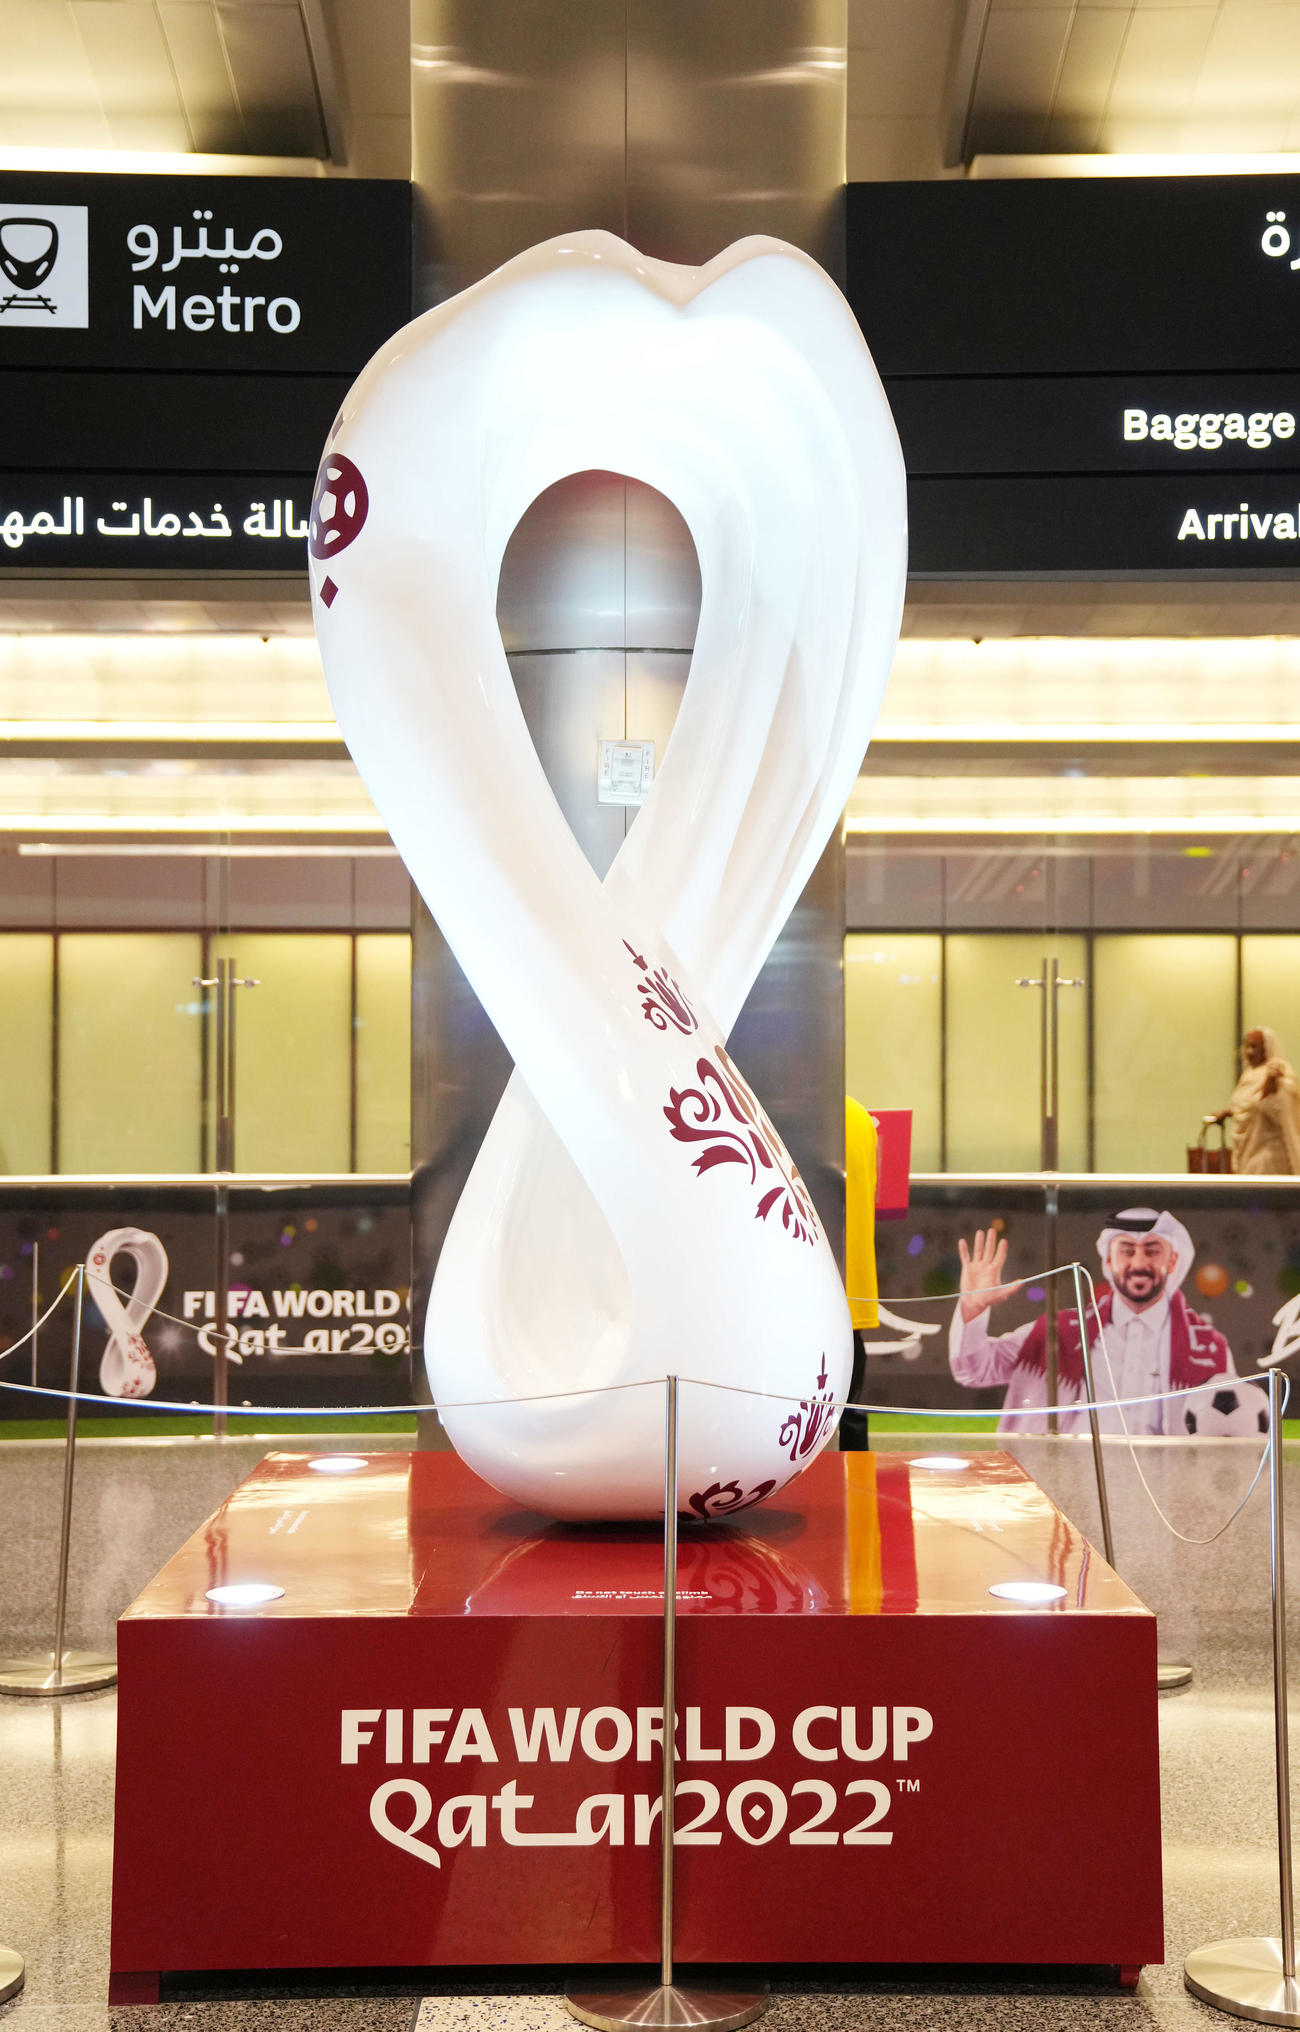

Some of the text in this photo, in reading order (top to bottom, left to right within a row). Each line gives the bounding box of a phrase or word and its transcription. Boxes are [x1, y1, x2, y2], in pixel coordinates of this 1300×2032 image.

[127, 210, 282, 273] ميترو
[133, 285, 301, 334] Metro
[1123, 409, 1296, 450] Baggage
[0, 496, 84, 549] المه
[97, 498, 232, 536] خدمات
[183, 1290, 270, 1319] FIFA
[272, 1289, 401, 1319] WORLD
[340, 1705, 934, 1764] FIFA WORLD CUP
